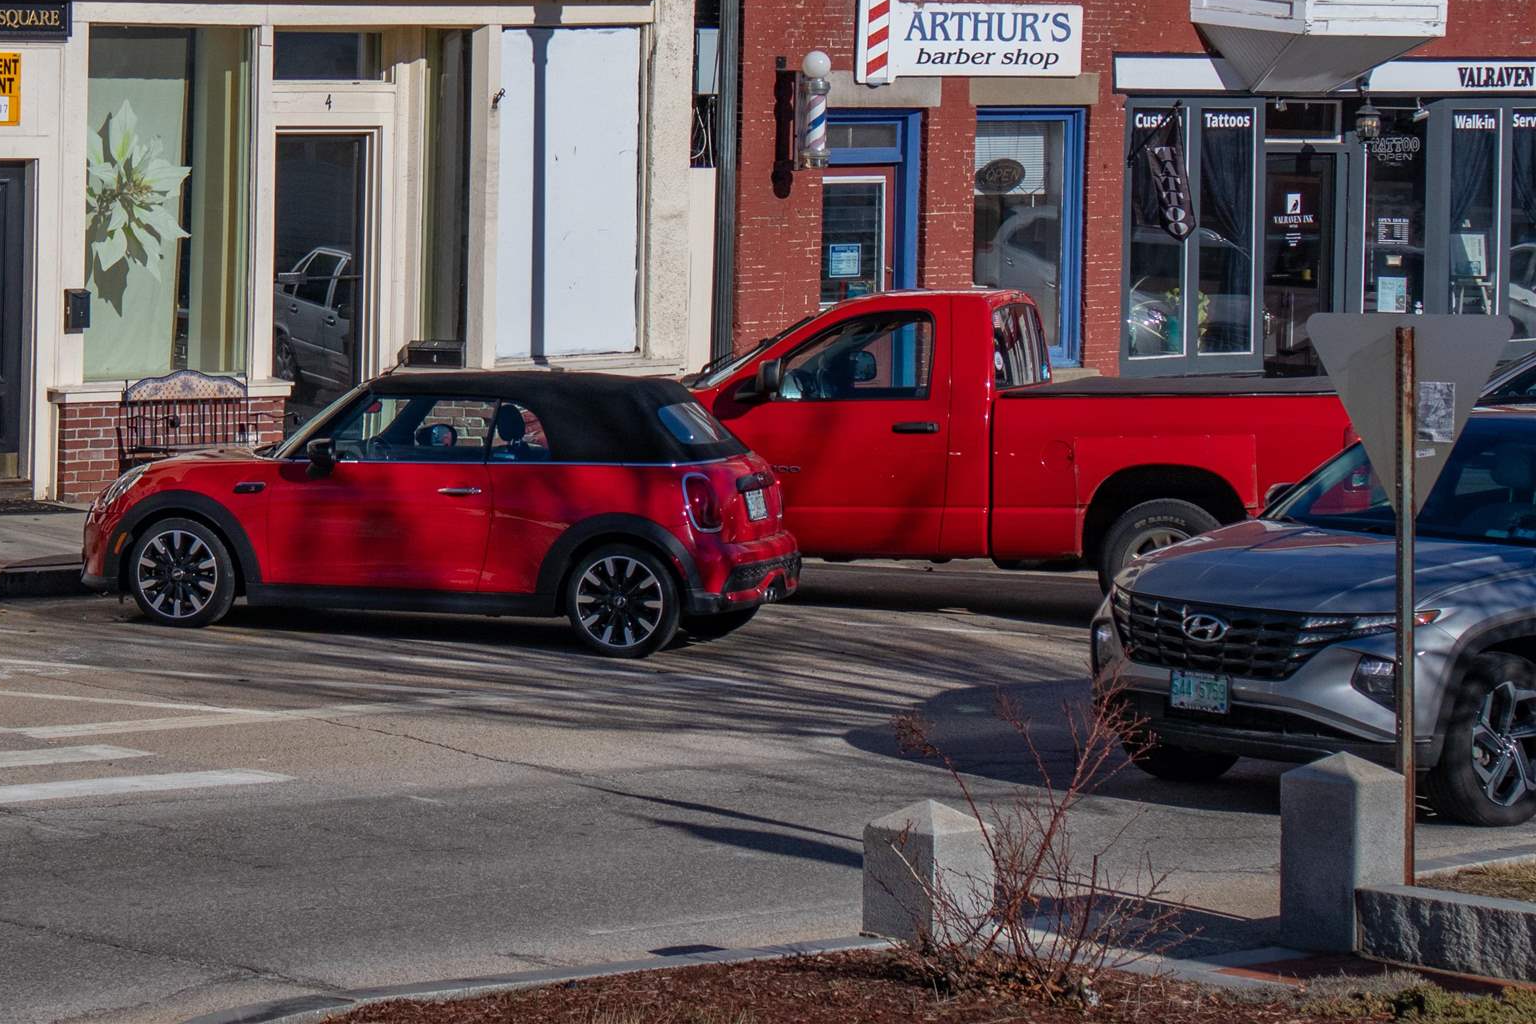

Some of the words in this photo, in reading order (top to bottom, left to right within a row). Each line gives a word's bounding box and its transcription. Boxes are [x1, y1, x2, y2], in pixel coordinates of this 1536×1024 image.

[904, 11, 1072, 42] ARTHUR'S
[916, 48, 996, 65] barber
[1001, 48, 1059, 69] shop
[1457, 66, 1535, 88] VALRAVEN
[325, 94, 332, 111] 4
[1205, 113, 1251, 128] Tattoos
[1454, 114, 1496, 129] Walk-in
[1371, 136, 1421, 153] TATTOO
[1377, 153, 1413, 161] OPEN
